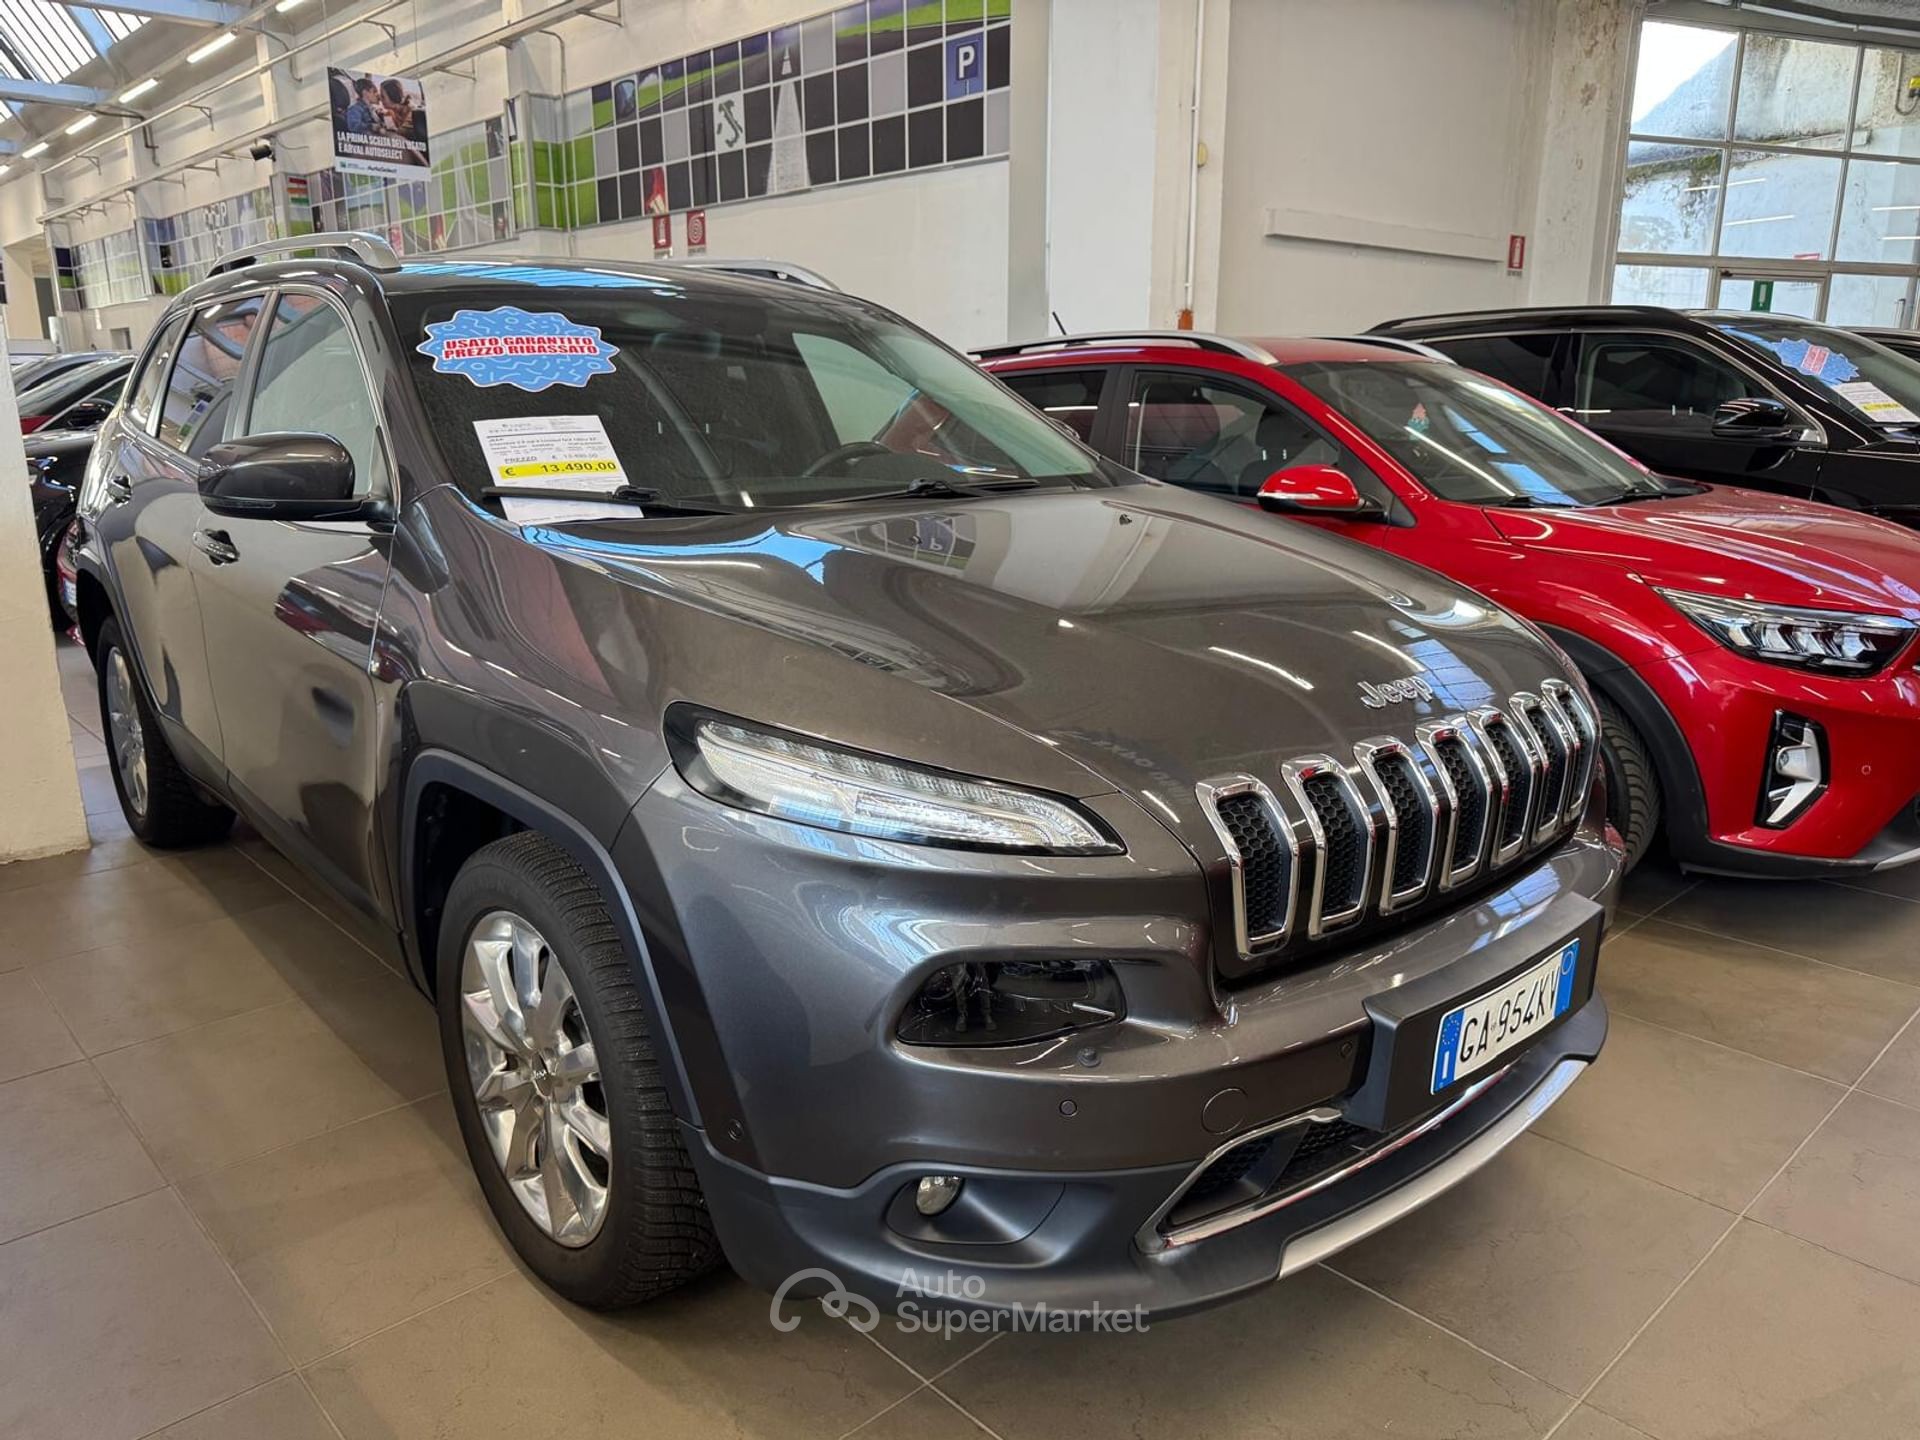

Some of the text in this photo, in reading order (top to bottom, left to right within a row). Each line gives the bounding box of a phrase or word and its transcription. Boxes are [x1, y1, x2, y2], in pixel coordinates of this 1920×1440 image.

[959, 45, 975, 79] P
[337, 131, 346, 141] LA
[346, 132, 368, 144] PRIMA
[369, 135, 391, 147] SCELTA
[343, 143, 364, 155] ARVAL
[365, 146, 403, 160] AUTOSELECT
[445, 336, 593, 349] USATO GARANTITO
[444, 345, 598, 359] PREZZO RIBASSATO
[505, 462, 617, 476] € 13.490,00
[1357, 676, 1433, 708] Jeep
